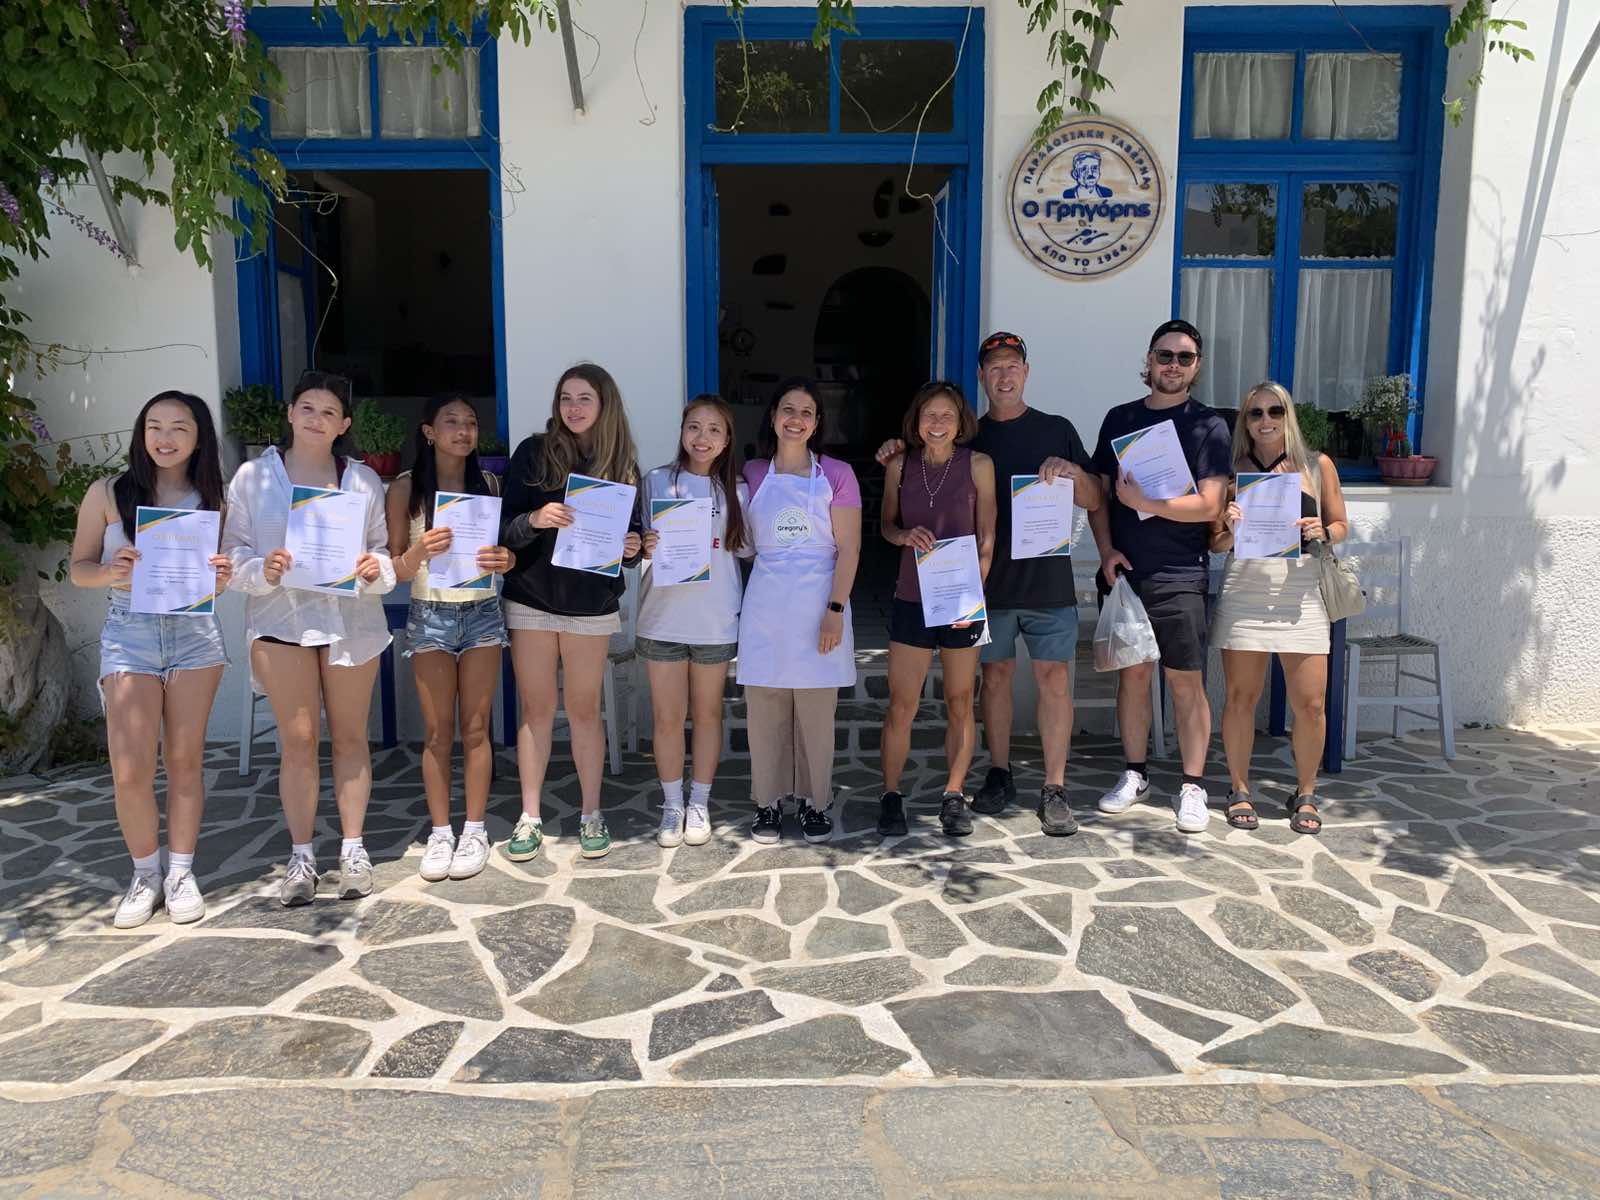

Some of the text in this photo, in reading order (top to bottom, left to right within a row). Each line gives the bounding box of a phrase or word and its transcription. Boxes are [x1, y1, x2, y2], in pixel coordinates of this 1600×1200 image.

[1022, 199, 1151, 223] Ο Γρηγόρης
[1073, 257, 1090, 266] ΤΟ
[1097, 244, 1128, 264] 1964
[777, 524, 808, 533] Gregory's
